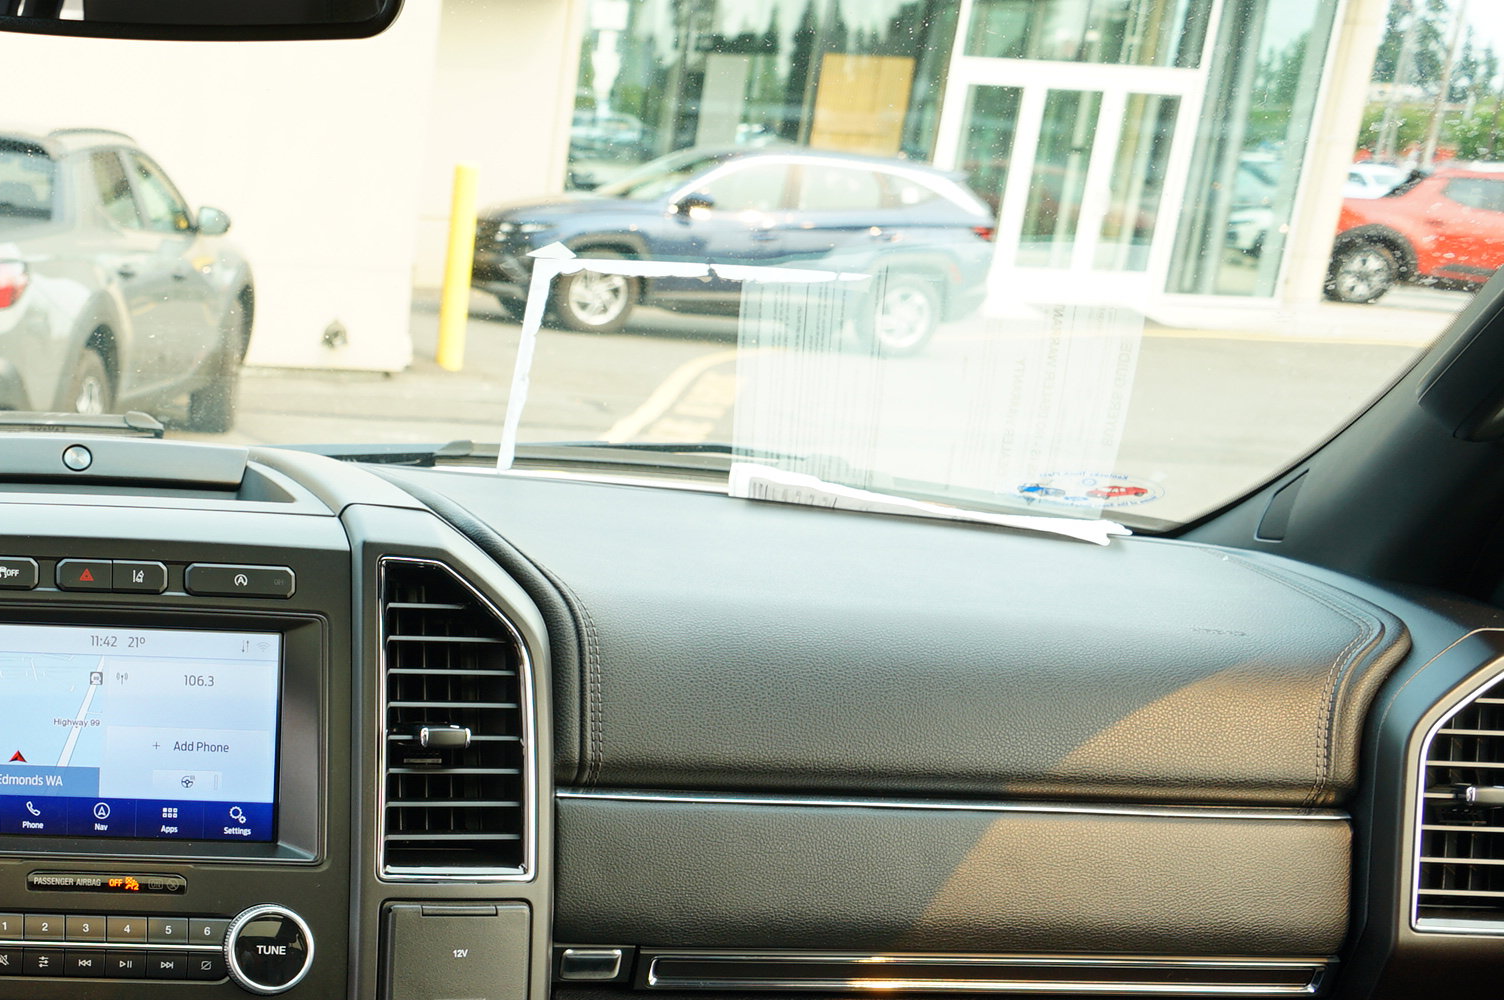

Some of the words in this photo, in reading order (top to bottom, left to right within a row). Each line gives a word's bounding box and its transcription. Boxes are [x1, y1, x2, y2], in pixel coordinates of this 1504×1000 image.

[6, 568, 20, 577] OFF
[90, 633, 118, 648] 11:42
[183, 673, 216, 688] 106.3
[53, 717, 88, 728] Highway
[90, 719, 101, 727] 99
[173, 740, 195, 753] Add
[196, 740, 230, 754] Phone
[45, 773, 64, 787] WA
[22, 820, 44, 830] Phone
[94, 822, 108, 832] Nav
[160, 824, 178, 835] Apps
[223, 825, 252, 837] Settings
[33, 876, 75, 887] PASSENGER
[76, 877, 102, 888] AIRBAG
[108, 878, 124, 888] OFF
[1, 921, 8, 931] 1
[41, 922, 49, 932] 2
[82, 923, 90, 933] 3
[123, 924, 131, 934] 4
[165, 925, 172, 935] 5
[203, 926, 211, 936] 6
[256, 944, 287, 957] TUNE
[452, 948, 469, 959] 12V
